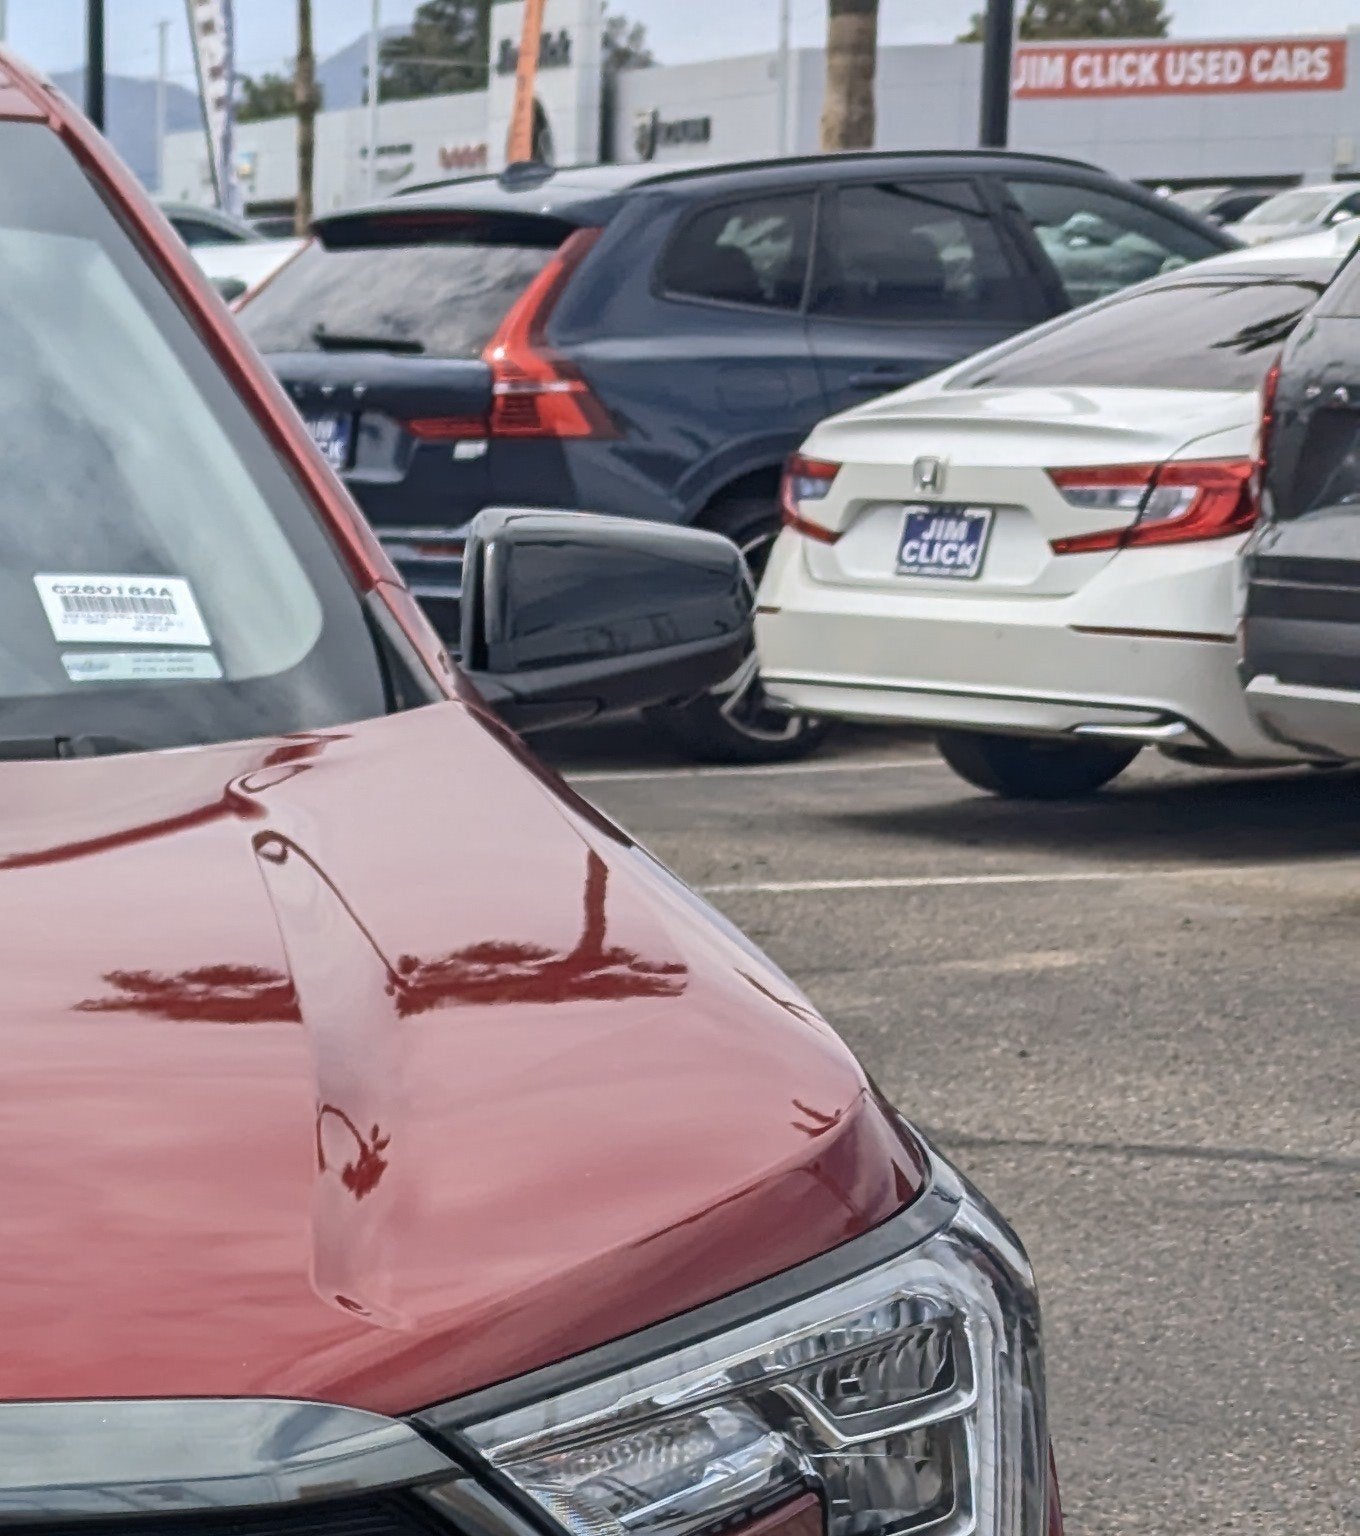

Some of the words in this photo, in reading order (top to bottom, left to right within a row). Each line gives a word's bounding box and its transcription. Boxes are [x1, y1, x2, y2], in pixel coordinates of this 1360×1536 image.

[1013, 56, 1065, 91] JIM
[1071, 51, 1160, 89] CLICK
[1165, 48, 1246, 87] USED
[1250, 46, 1332, 84] CARS
[921, 518, 969, 541] JIM
[901, 539, 977, 565] CLICK
